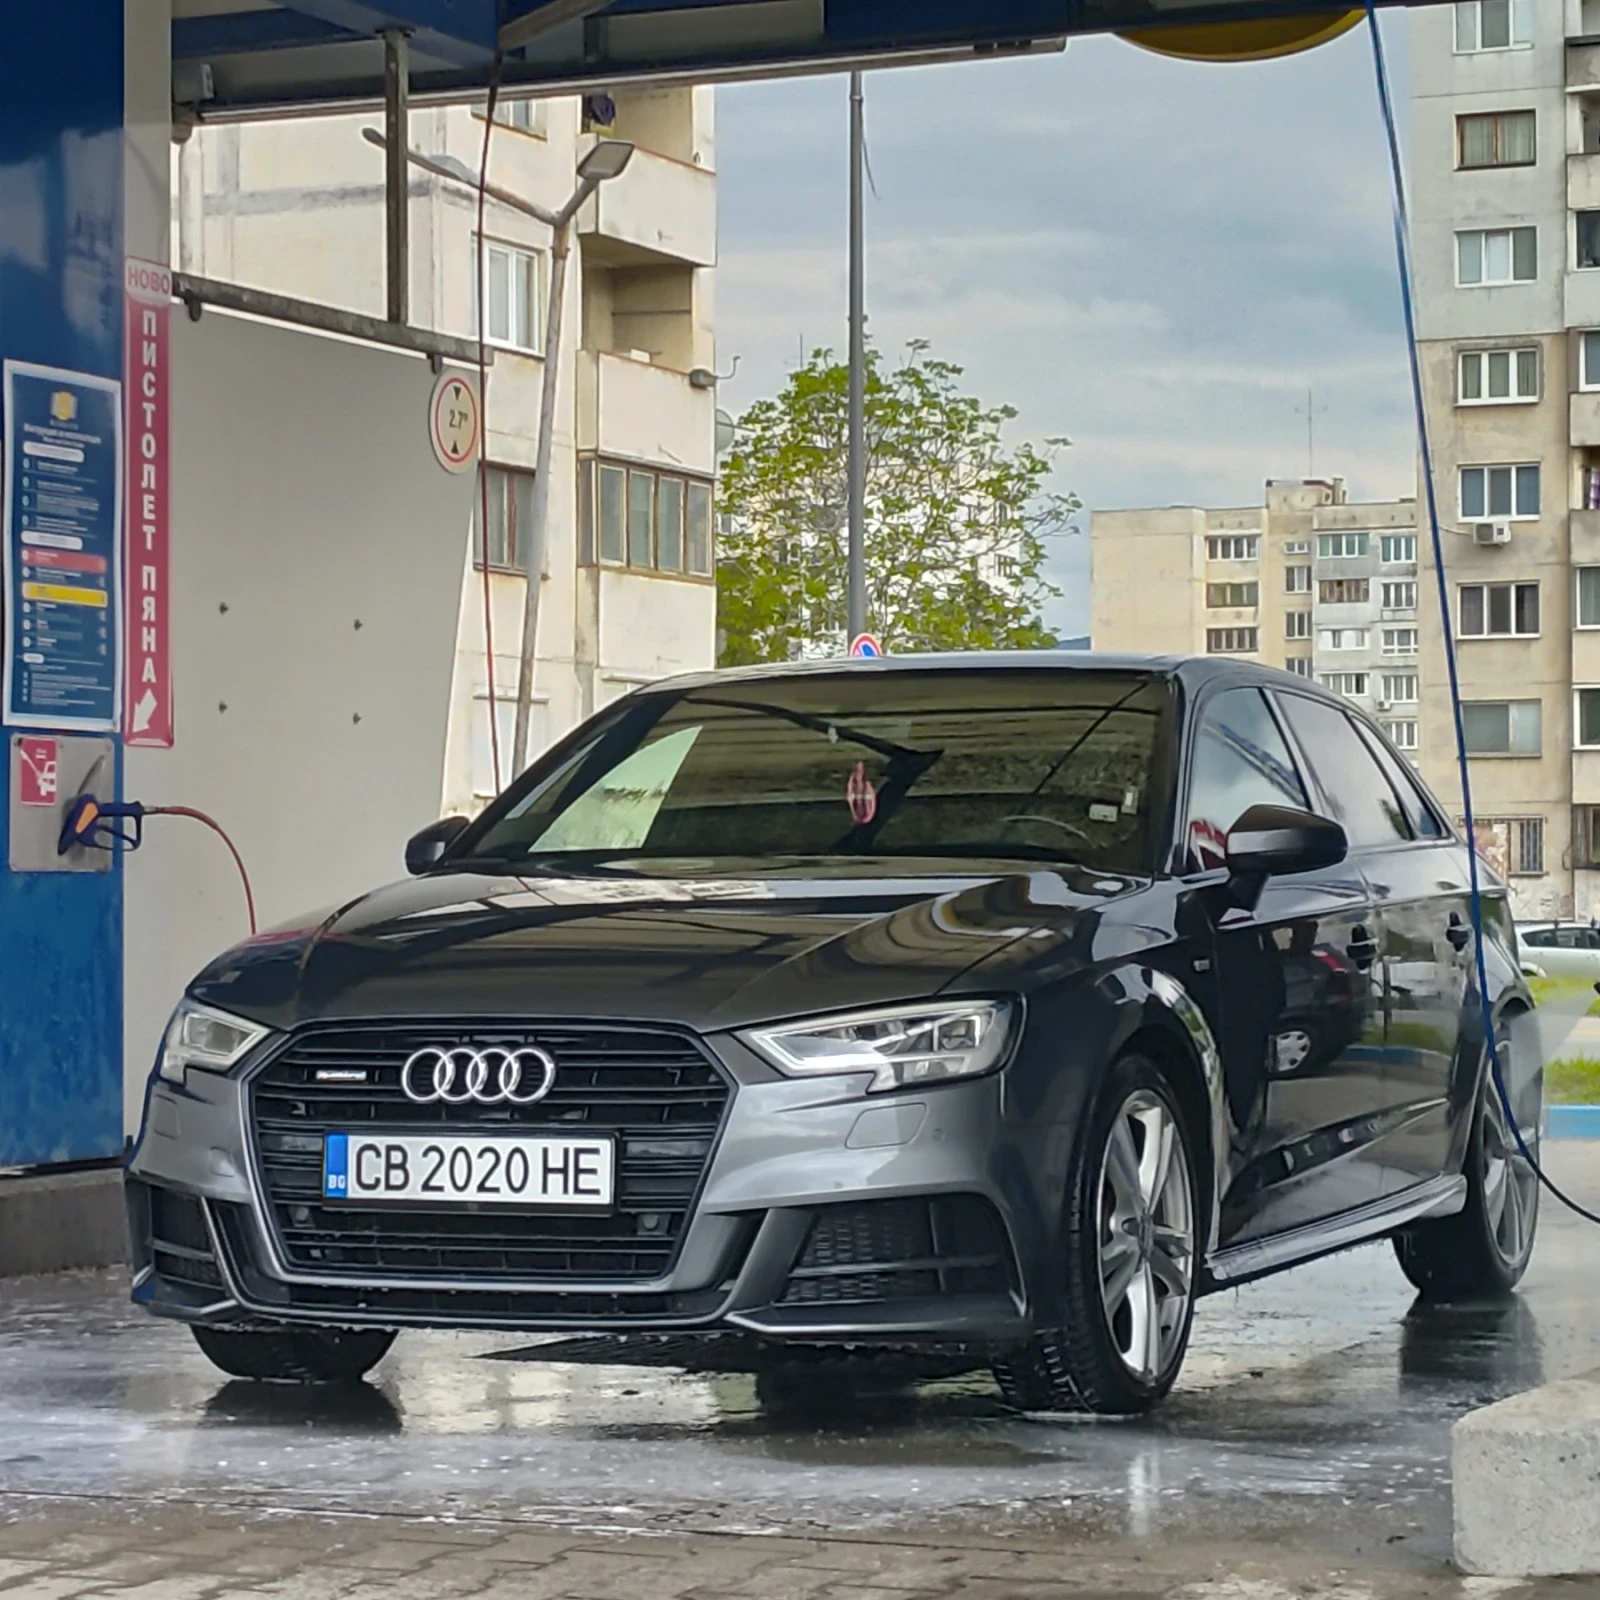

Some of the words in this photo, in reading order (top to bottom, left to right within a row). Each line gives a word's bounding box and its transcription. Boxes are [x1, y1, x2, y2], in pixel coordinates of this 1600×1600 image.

[127, 265, 170, 294] НОВО
[141, 309, 157, 551] ПИСТОЛЕТ
[141, 564, 157, 683] ПЯНА
[355, 1143, 410, 1192] CB
[420, 1144, 530, 1194] 2020
[541, 1146, 601, 1196] HE
